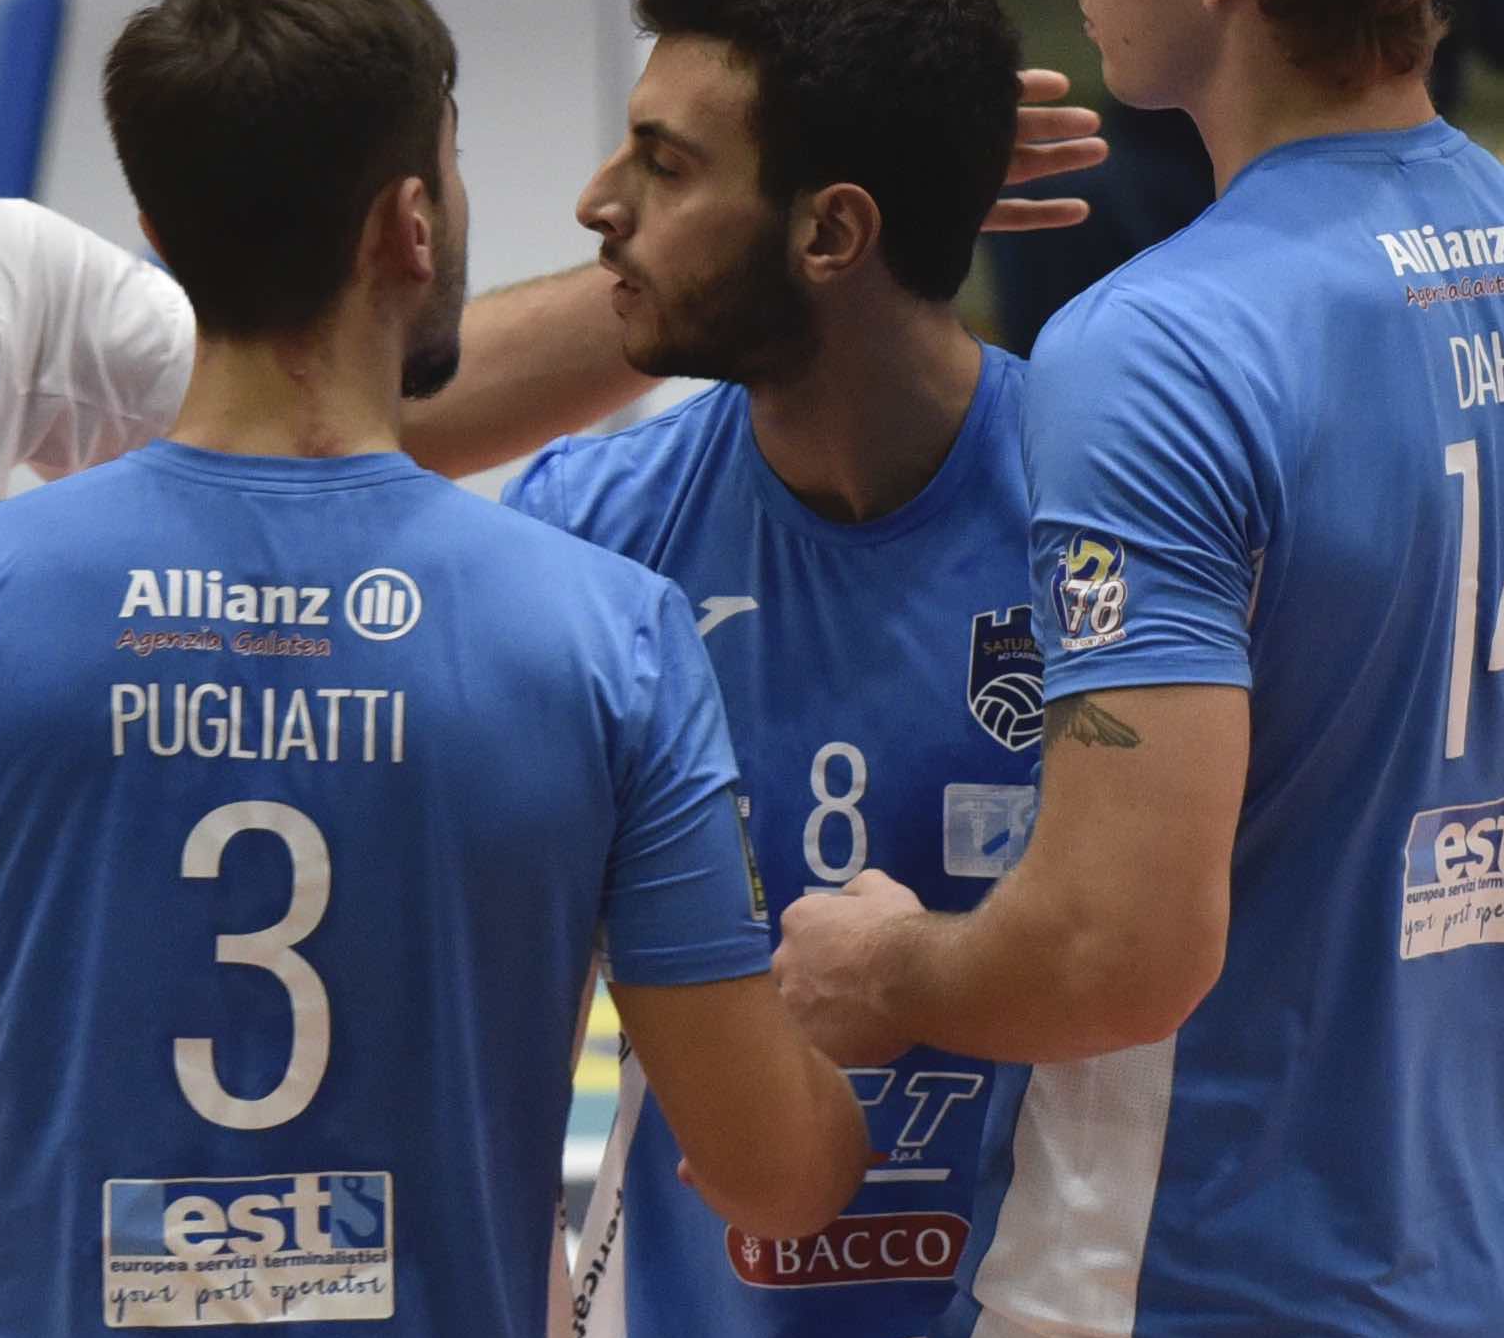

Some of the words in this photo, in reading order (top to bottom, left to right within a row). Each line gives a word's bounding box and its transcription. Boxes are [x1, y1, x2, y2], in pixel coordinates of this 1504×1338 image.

[118, 568, 330, 625] Allianz
[115, 627, 223, 657] Agenzia
[110, 683, 404, 763] PUGLIATTI
[803, 741, 867, 882] 8
[173, 800, 332, 1131] 3
[163, 1175, 333, 1258] est
[110, 1260, 189, 1274] europea
[195, 1253, 258, 1273] servizi
[263, 1249, 388, 1268] terminalistici
[773, 1228, 952, 1275] BACCO
[110, 1284, 177, 1323] your
[195, 1272, 254, 1320] port
[269, 1269, 386, 1316] operator
